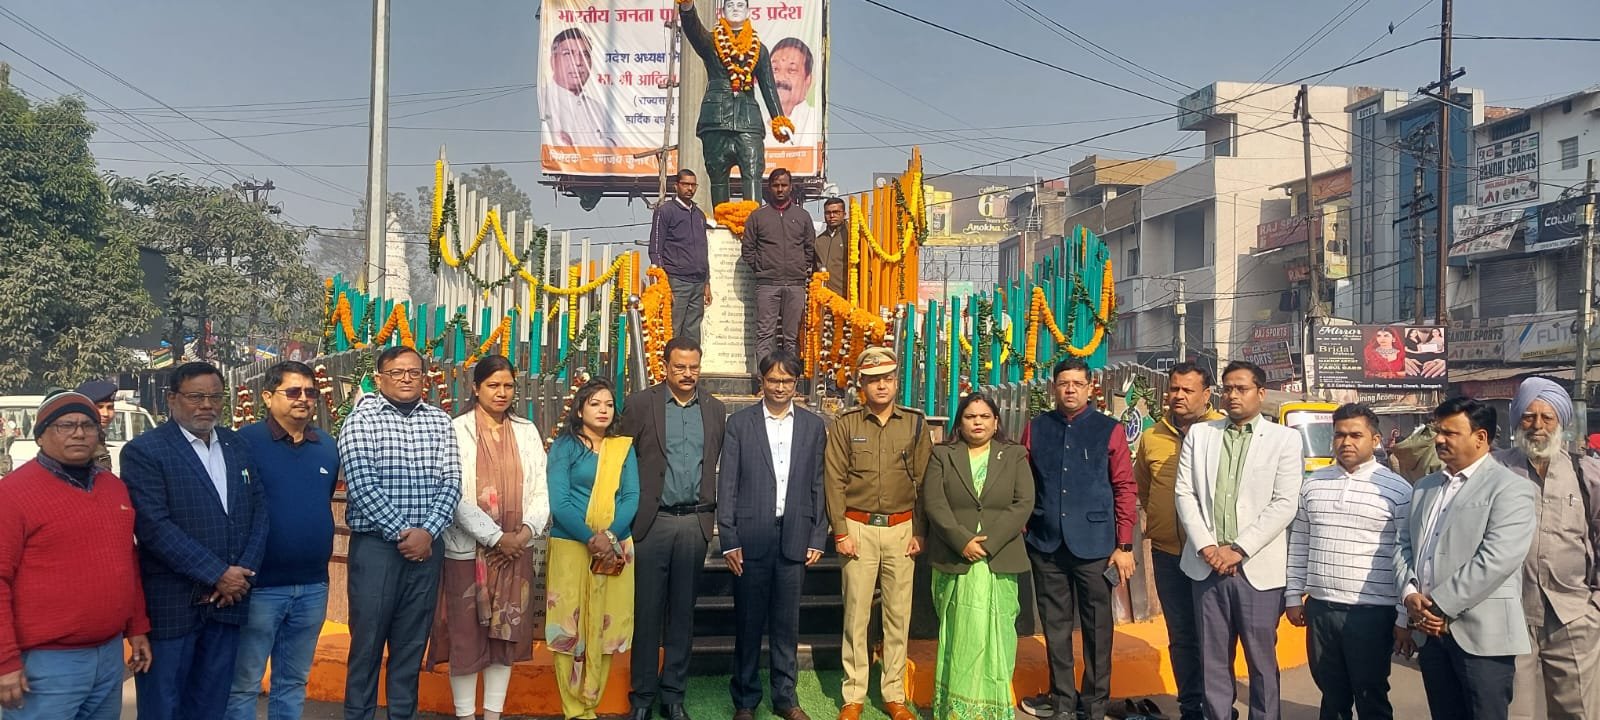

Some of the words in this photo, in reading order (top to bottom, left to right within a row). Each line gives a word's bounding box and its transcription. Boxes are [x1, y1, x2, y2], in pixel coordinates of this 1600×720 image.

[558, 6, 609, 23] भारतीय
[615, 8, 653, 22] जनता
[767, 2, 802, 20] प्रदेश
[634, 52, 665, 63] अध्यक्ष
[624, 112, 651, 124] हार्दिक
[1480, 160, 1505, 181] GANDHI
[1507, 152, 1537, 175] SPORTS
[1260, 221, 1278, 235] RAJ
[1266, 327, 1287, 337] SPORTS
[1318, 326, 1362, 335] Mirror
[1473, 328, 1504, 341] SPORTS
[1245, 353, 1273, 366] SPORTS
